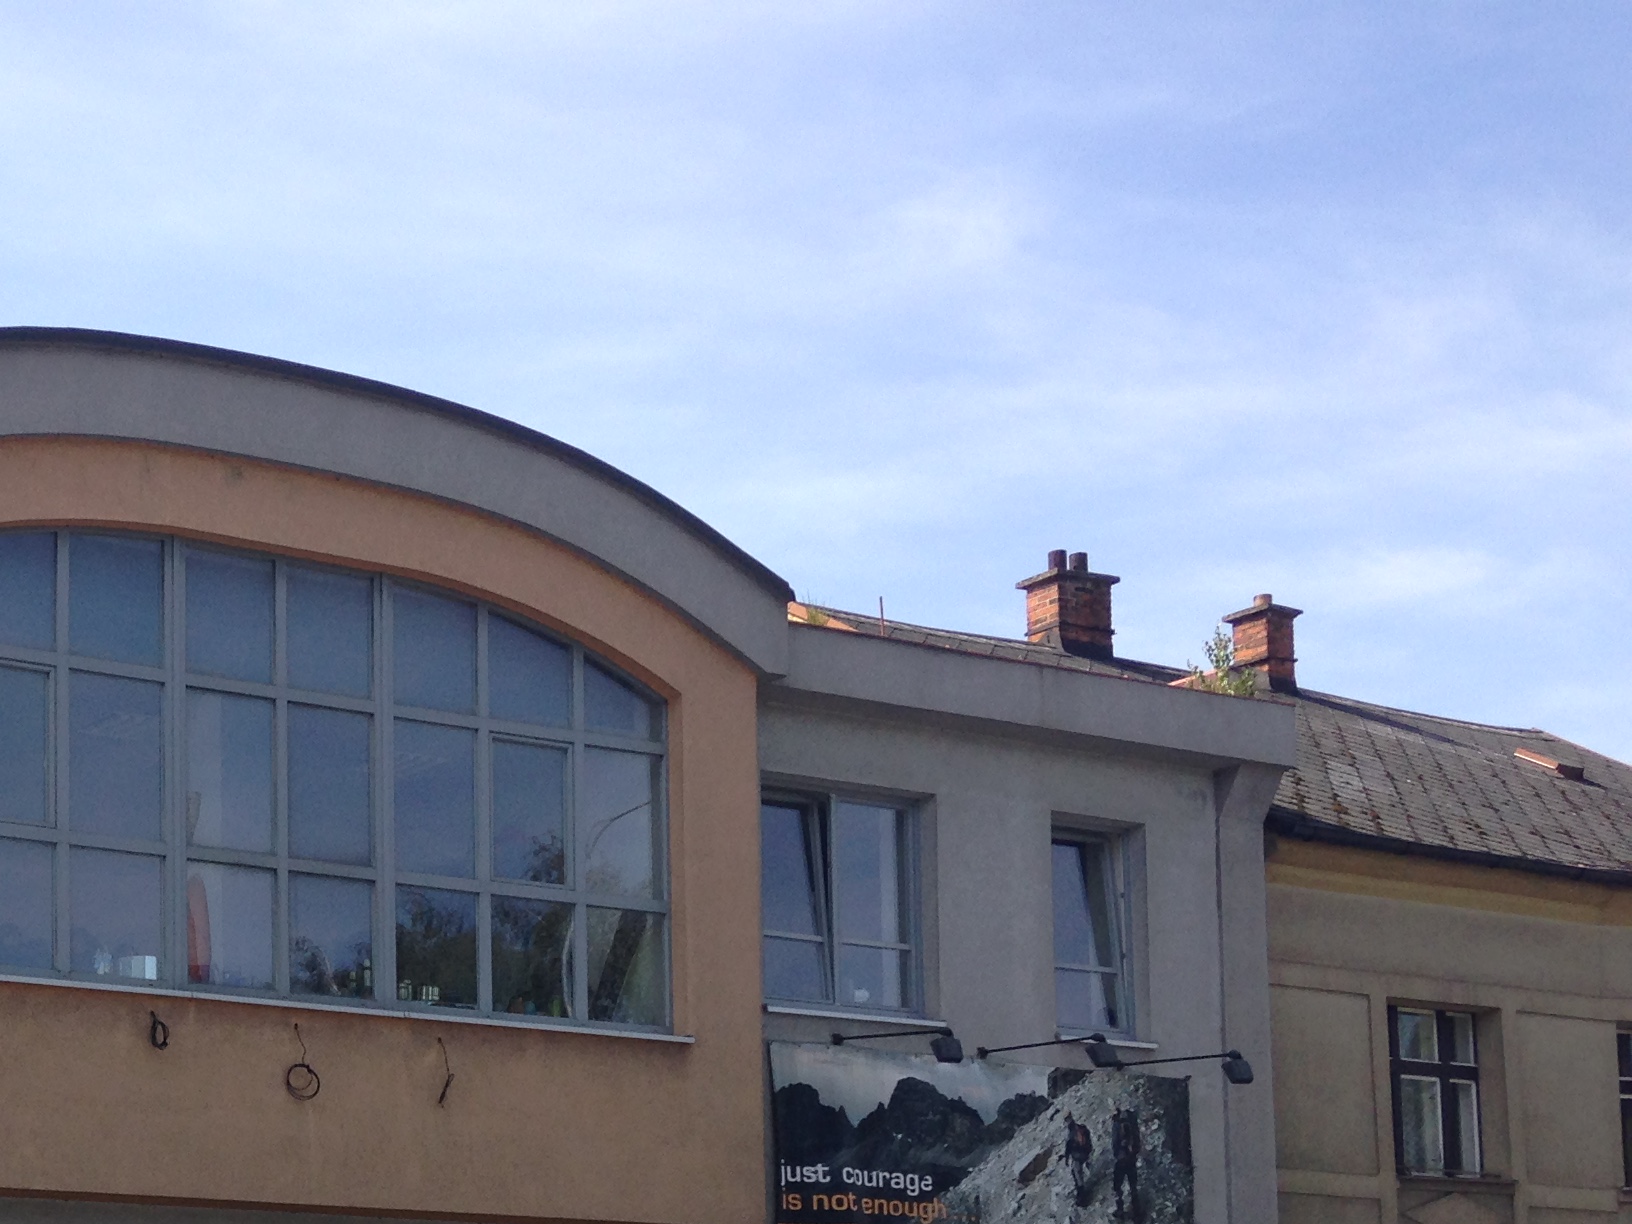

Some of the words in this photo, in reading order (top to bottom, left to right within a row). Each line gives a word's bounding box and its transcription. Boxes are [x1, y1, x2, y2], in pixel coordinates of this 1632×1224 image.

[780, 1158, 831, 1187] just
[842, 1165, 934, 1197] courage
[781, 1187, 803, 1211] is
[812, 1191, 858, 1212] not
